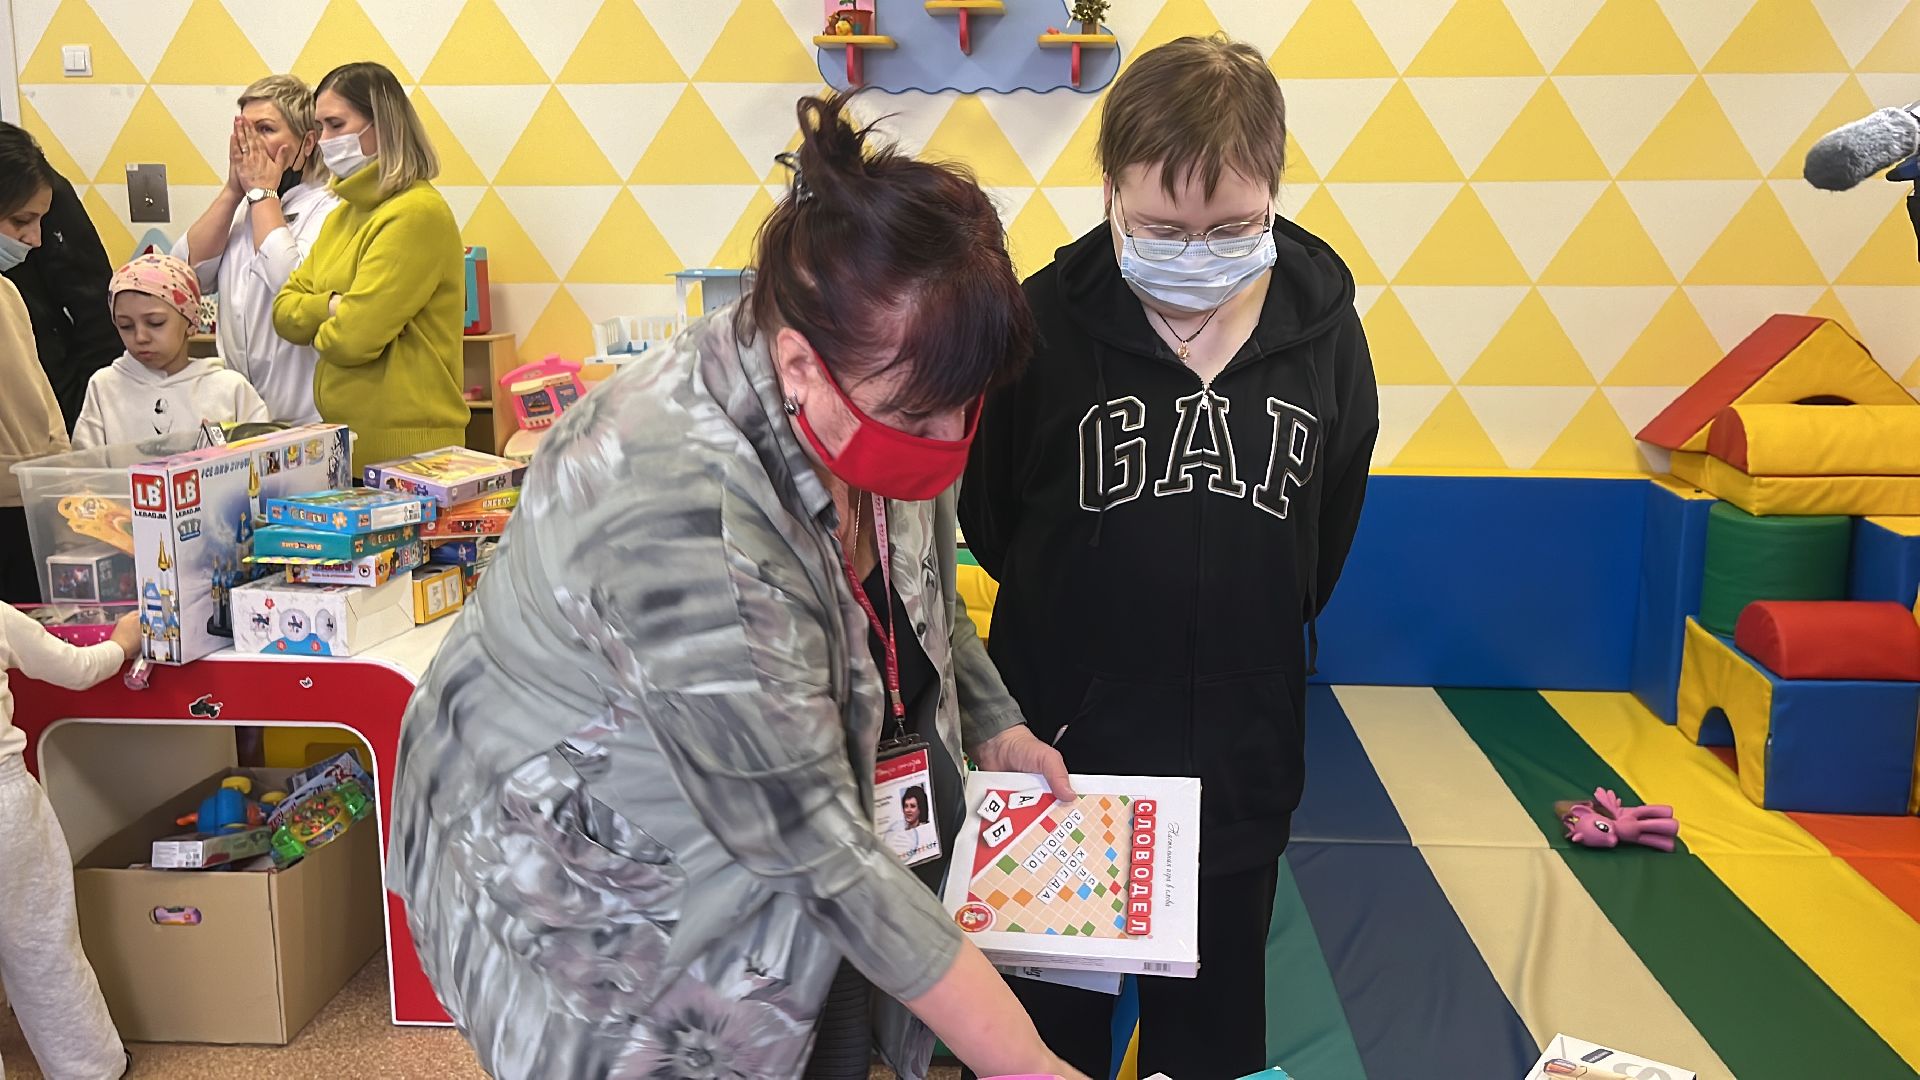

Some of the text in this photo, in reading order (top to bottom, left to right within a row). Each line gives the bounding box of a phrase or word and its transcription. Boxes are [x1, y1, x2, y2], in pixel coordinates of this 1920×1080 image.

[1078, 389, 1320, 520] GAP
[135, 483, 162, 507] LB
[175, 480, 197, 506] LB
[1028, 811, 1081, 869] ЗОЛОТО
[1131, 801, 1154, 932] СЛОВОДЕЛ
[1042, 849, 1086, 899] КОГДА
